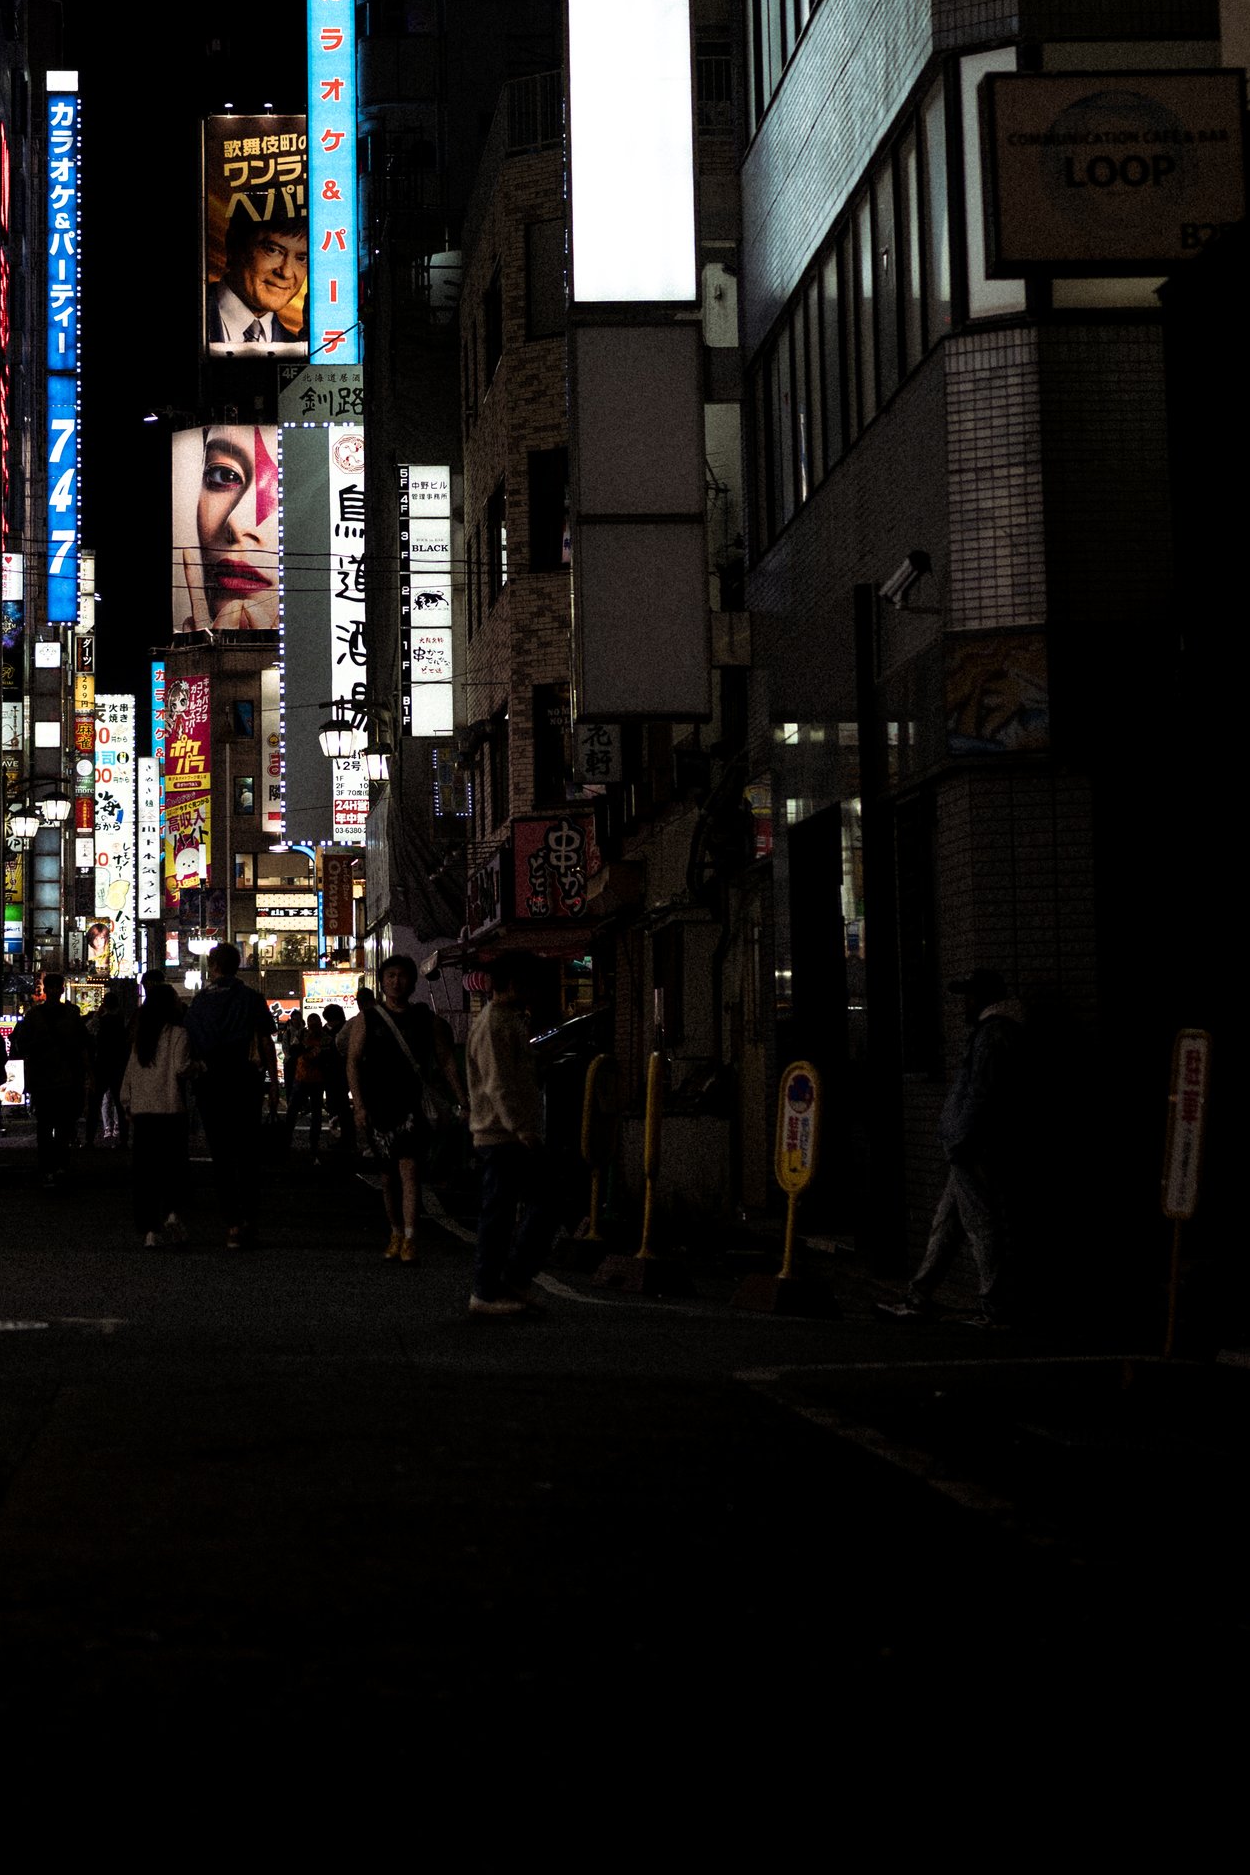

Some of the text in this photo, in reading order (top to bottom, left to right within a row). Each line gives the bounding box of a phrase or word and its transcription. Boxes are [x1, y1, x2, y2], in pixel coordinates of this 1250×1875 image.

[1008, 131, 1138, 147] COMMUNICATION
[1199, 129, 1228, 142] BAR
[223, 156, 307, 187] ワンラ
[1066, 156, 1176, 188] LOOP
[50, 102, 75, 353] カラオケ&パーティー
[282, 368, 298, 379] 4F
[400, 469, 408, 487] 5F
[411, 481, 447, 490] 中野ビル
[49, 419, 75, 574] 747
[400, 495, 408, 513] 4F
[401, 532, 409, 559] 3F
[401, 587, 410, 614] 2F
[402, 641, 410, 670] 1F
[403, 697, 411, 725] B1F
[75, 724, 93, 749] 麻雀
[179, 797, 210, 812] 今すぐ見つかる
[168, 808, 206, 835] 高収入
[174, 826, 208, 852] バイト
[327, 860, 342, 929] Orange
